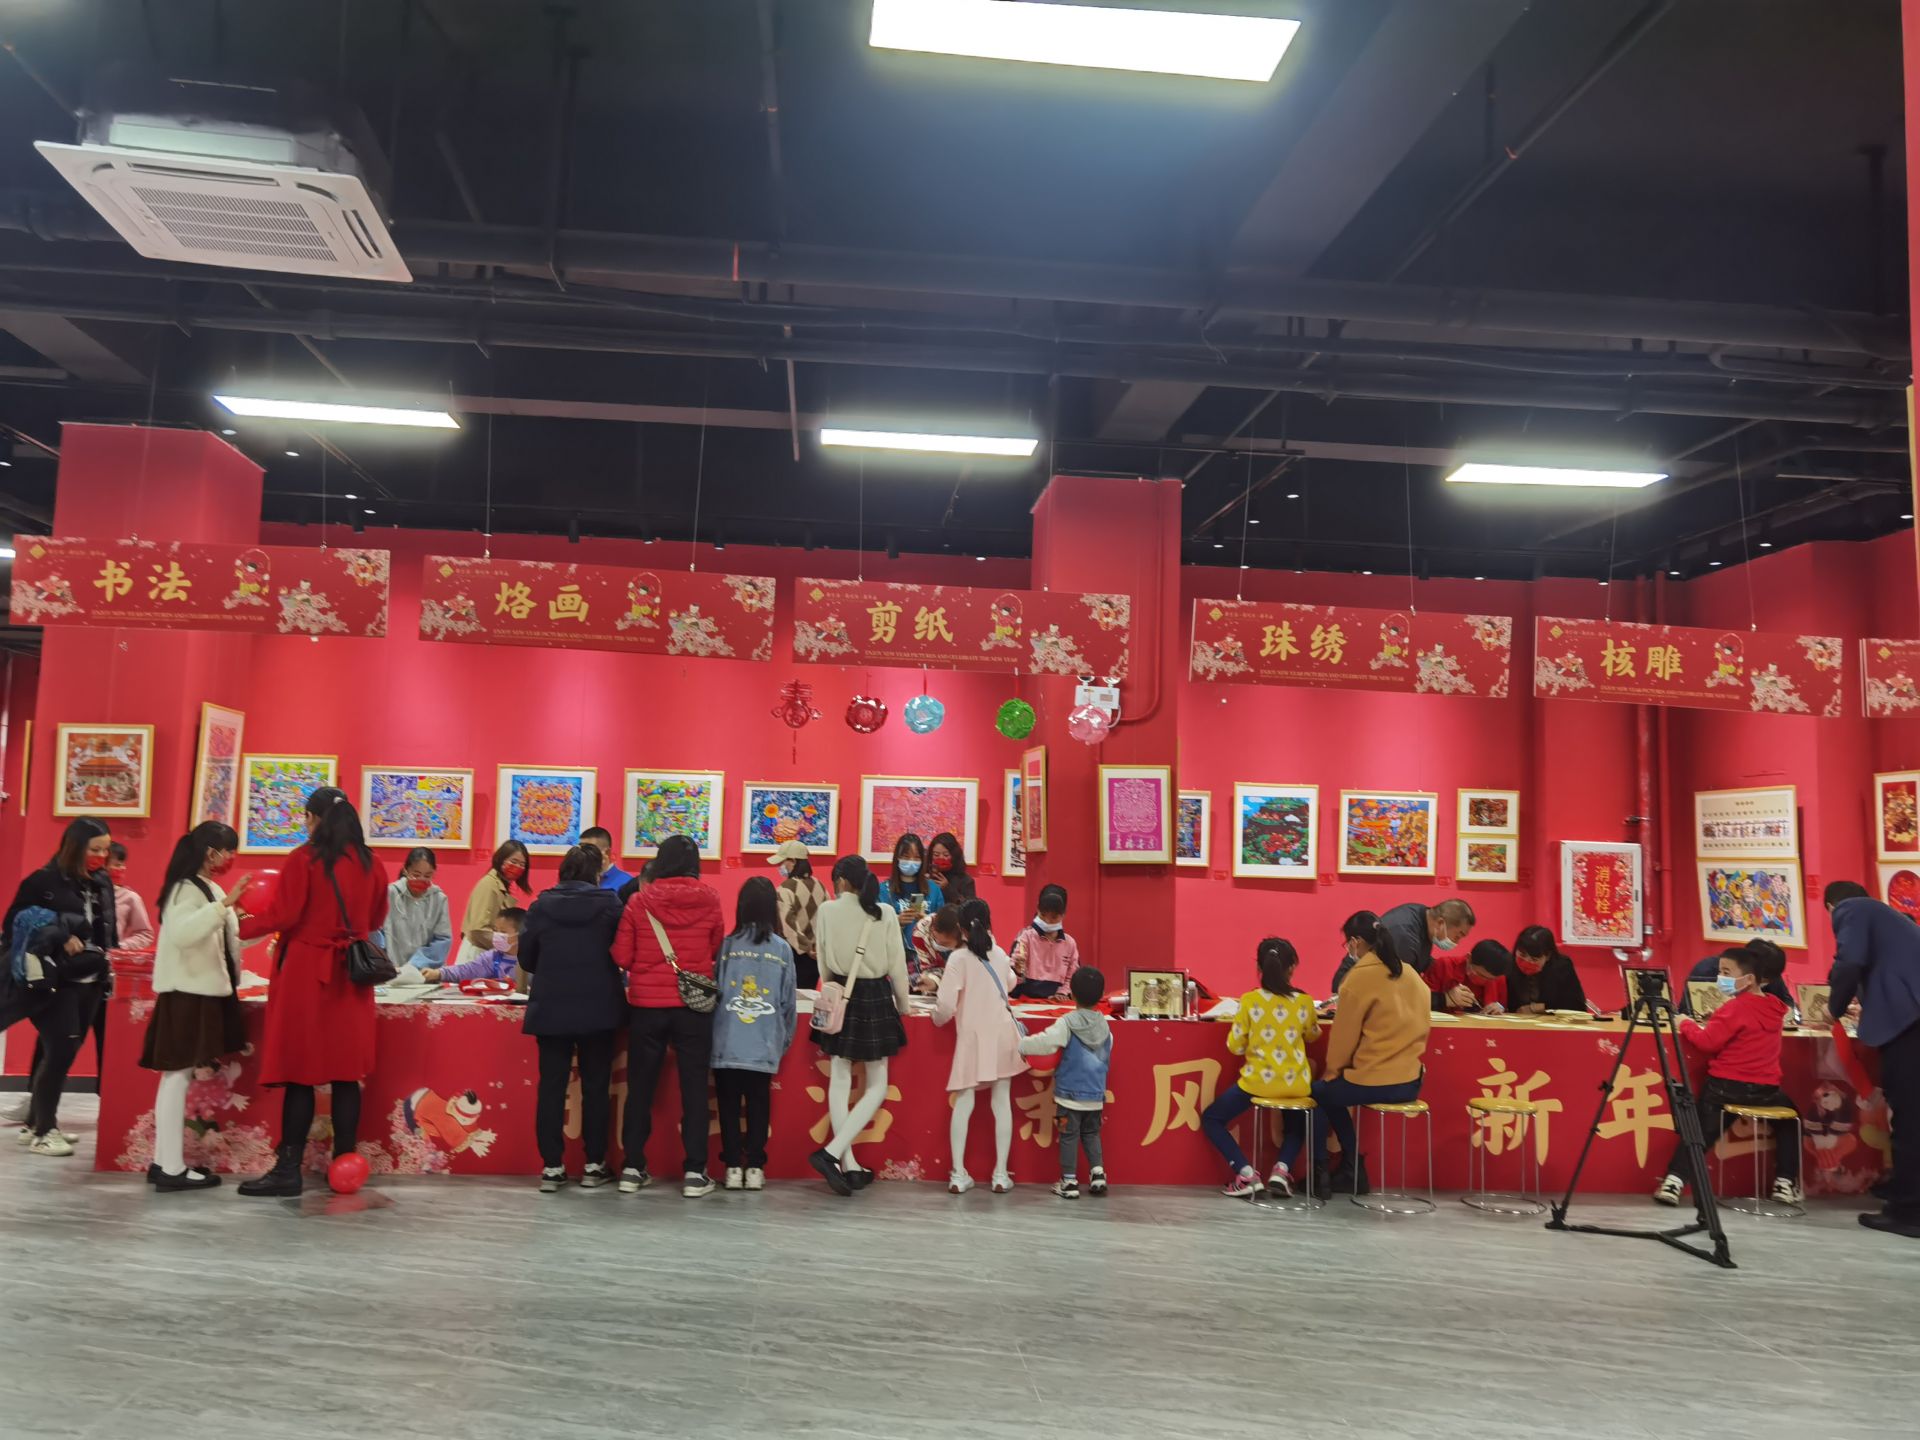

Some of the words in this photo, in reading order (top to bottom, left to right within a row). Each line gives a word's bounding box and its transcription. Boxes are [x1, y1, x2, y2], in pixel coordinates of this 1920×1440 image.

[93, 559, 192, 602] 书法
[494, 582, 590, 622] 烙画
[866, 600, 954, 644] 剪纸
[1259, 620, 1348, 664] 珠绣
[1600, 638, 1684, 681] 核雕
